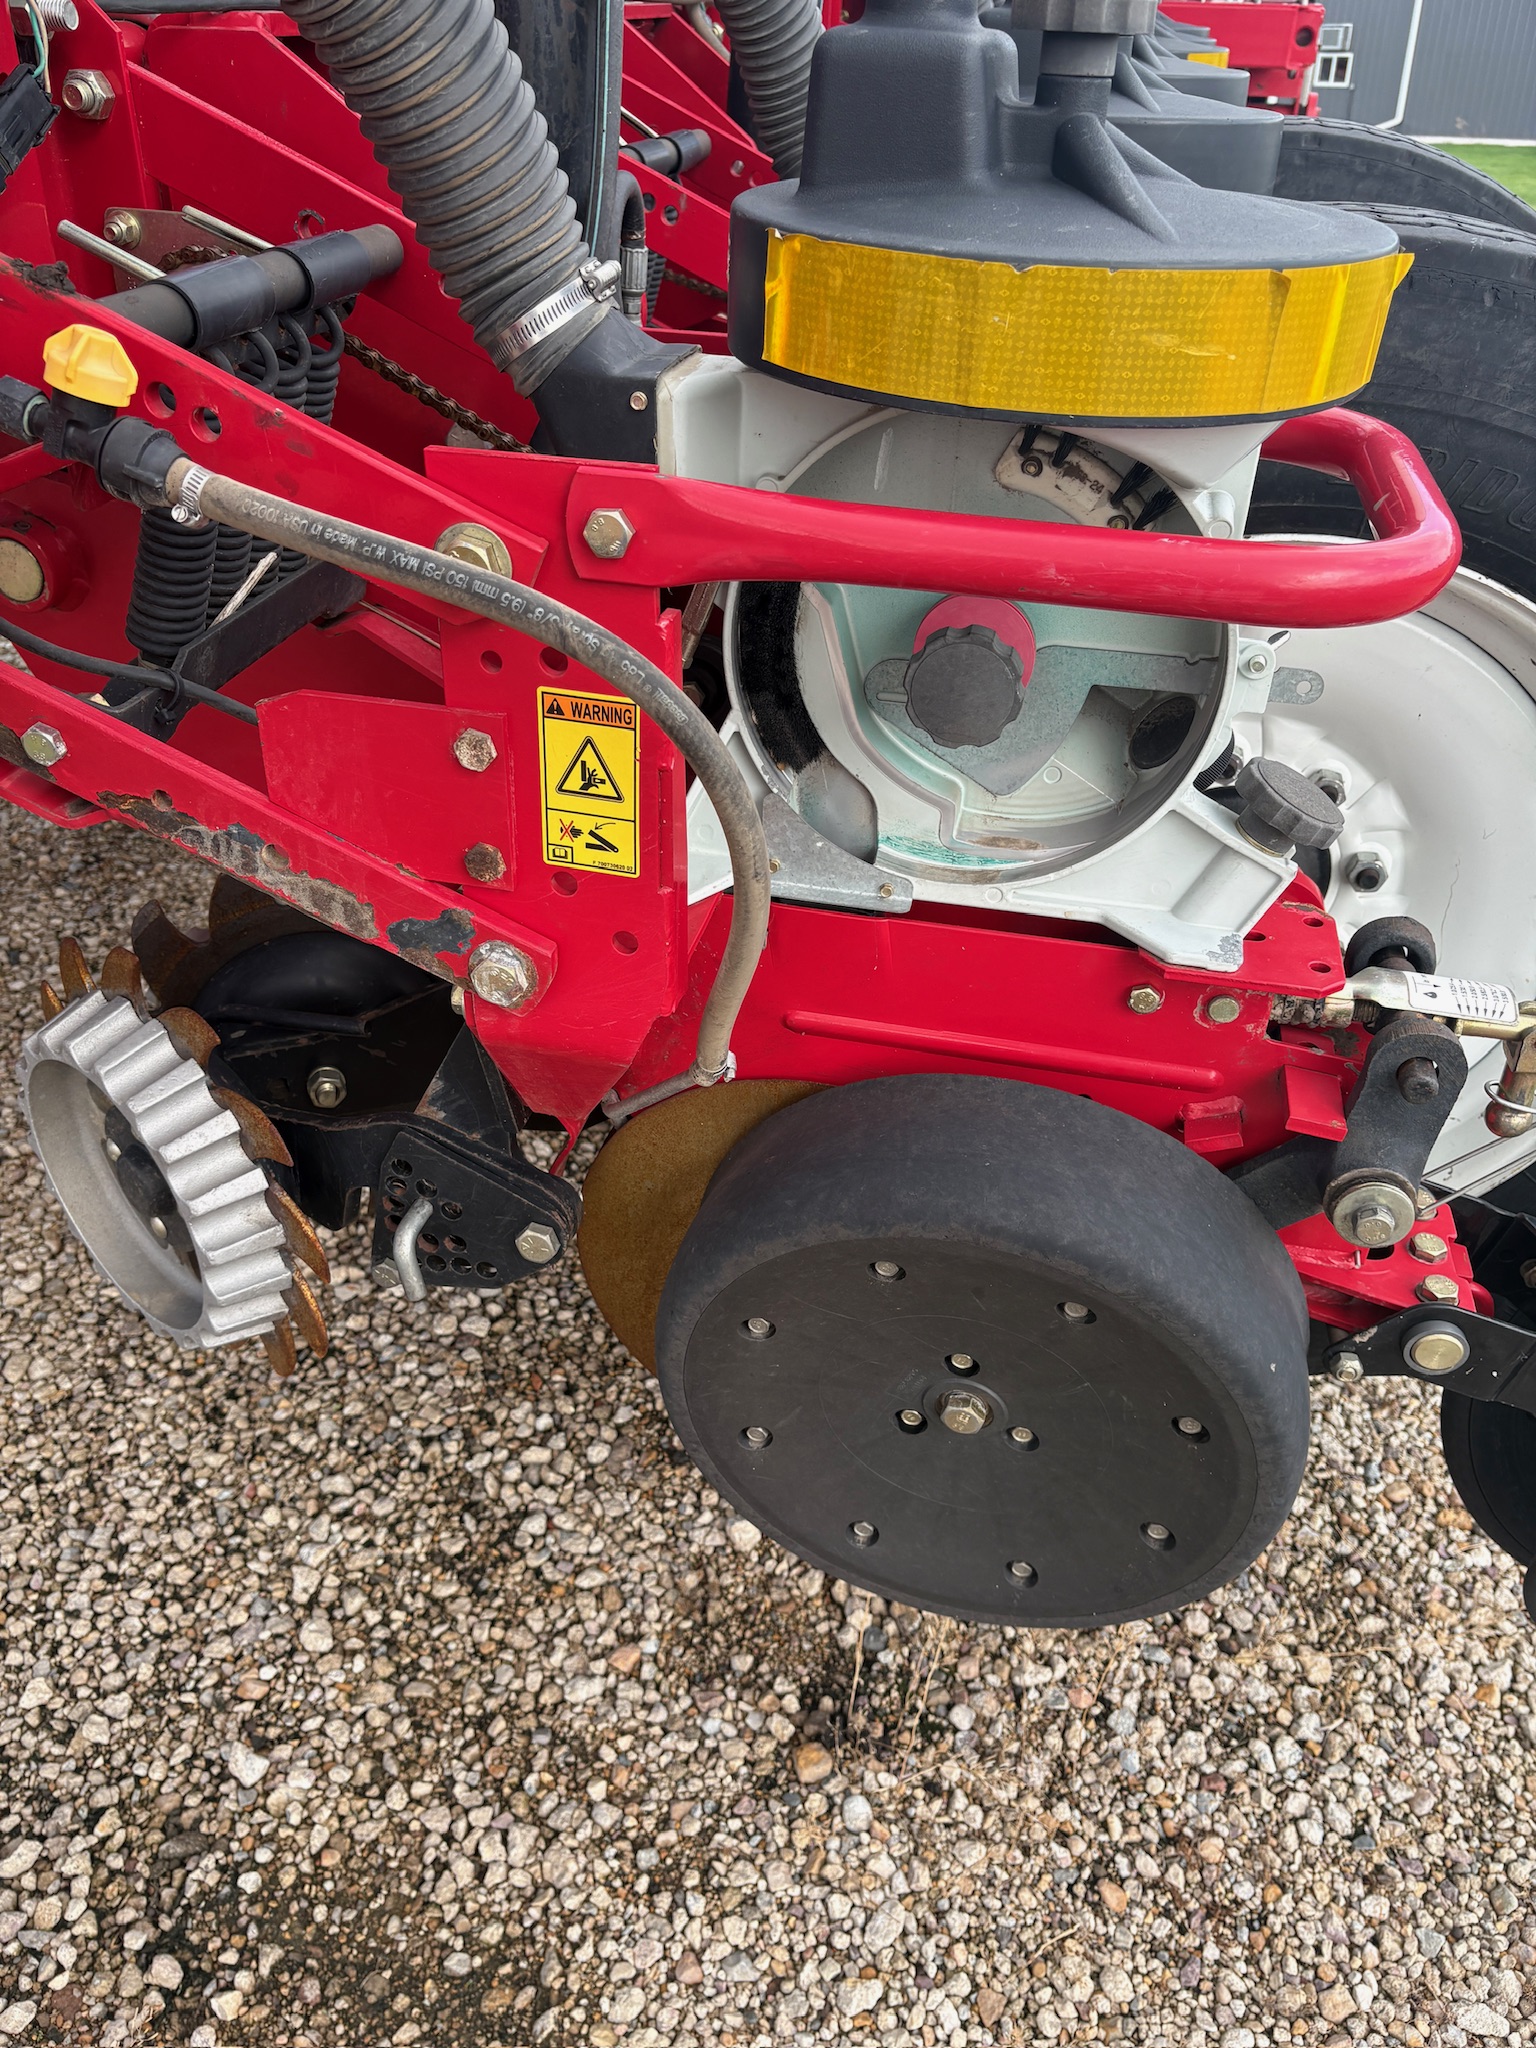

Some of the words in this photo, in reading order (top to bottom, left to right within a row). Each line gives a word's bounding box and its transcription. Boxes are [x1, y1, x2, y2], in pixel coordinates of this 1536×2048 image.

[282, 512, 309, 535] USA
[311, 523, 323, 540] in
[323, 527, 359, 552] Made
[389, 550, 421, 572] MAX
[421, 561, 446, 580] PSI
[445, 570, 470, 590] 150
[570, 701, 633, 726] WARNING
